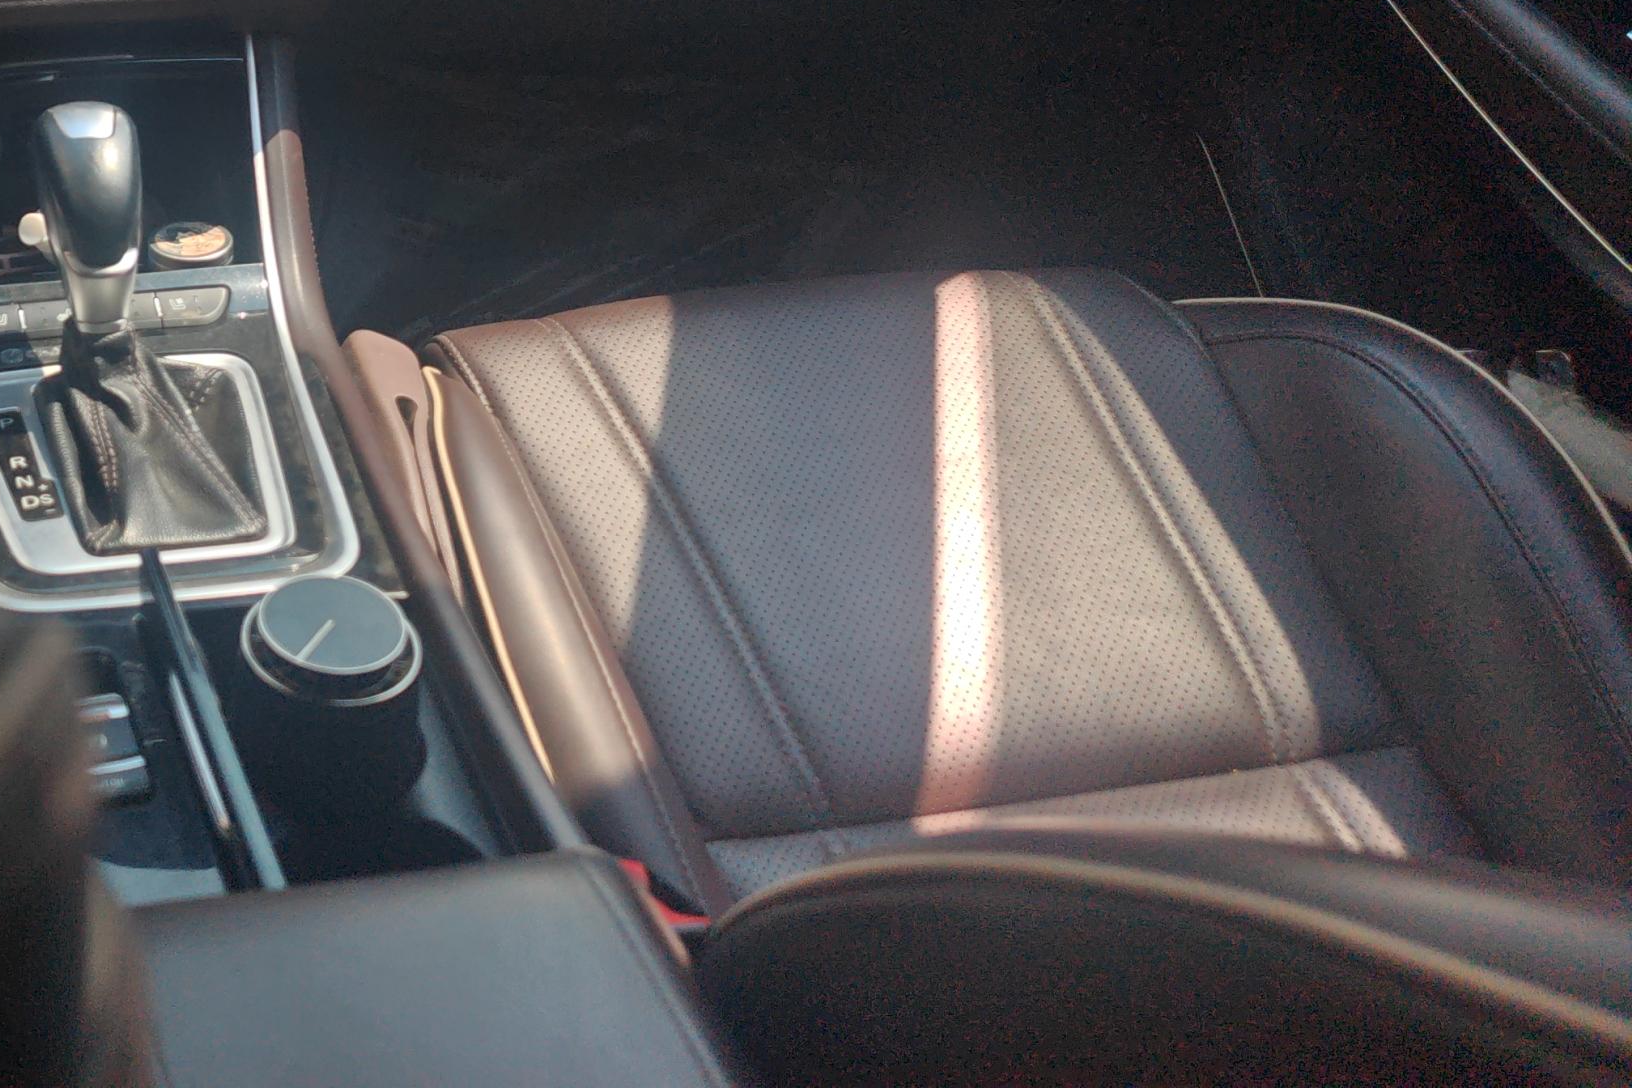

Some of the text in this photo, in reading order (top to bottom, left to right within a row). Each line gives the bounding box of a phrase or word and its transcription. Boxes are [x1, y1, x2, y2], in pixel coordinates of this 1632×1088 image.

[0, 417, 14, 429] P
[9, 456, 28, 470] R
[15, 475, 34, 489] N
[21, 494, 55, 510] D S
